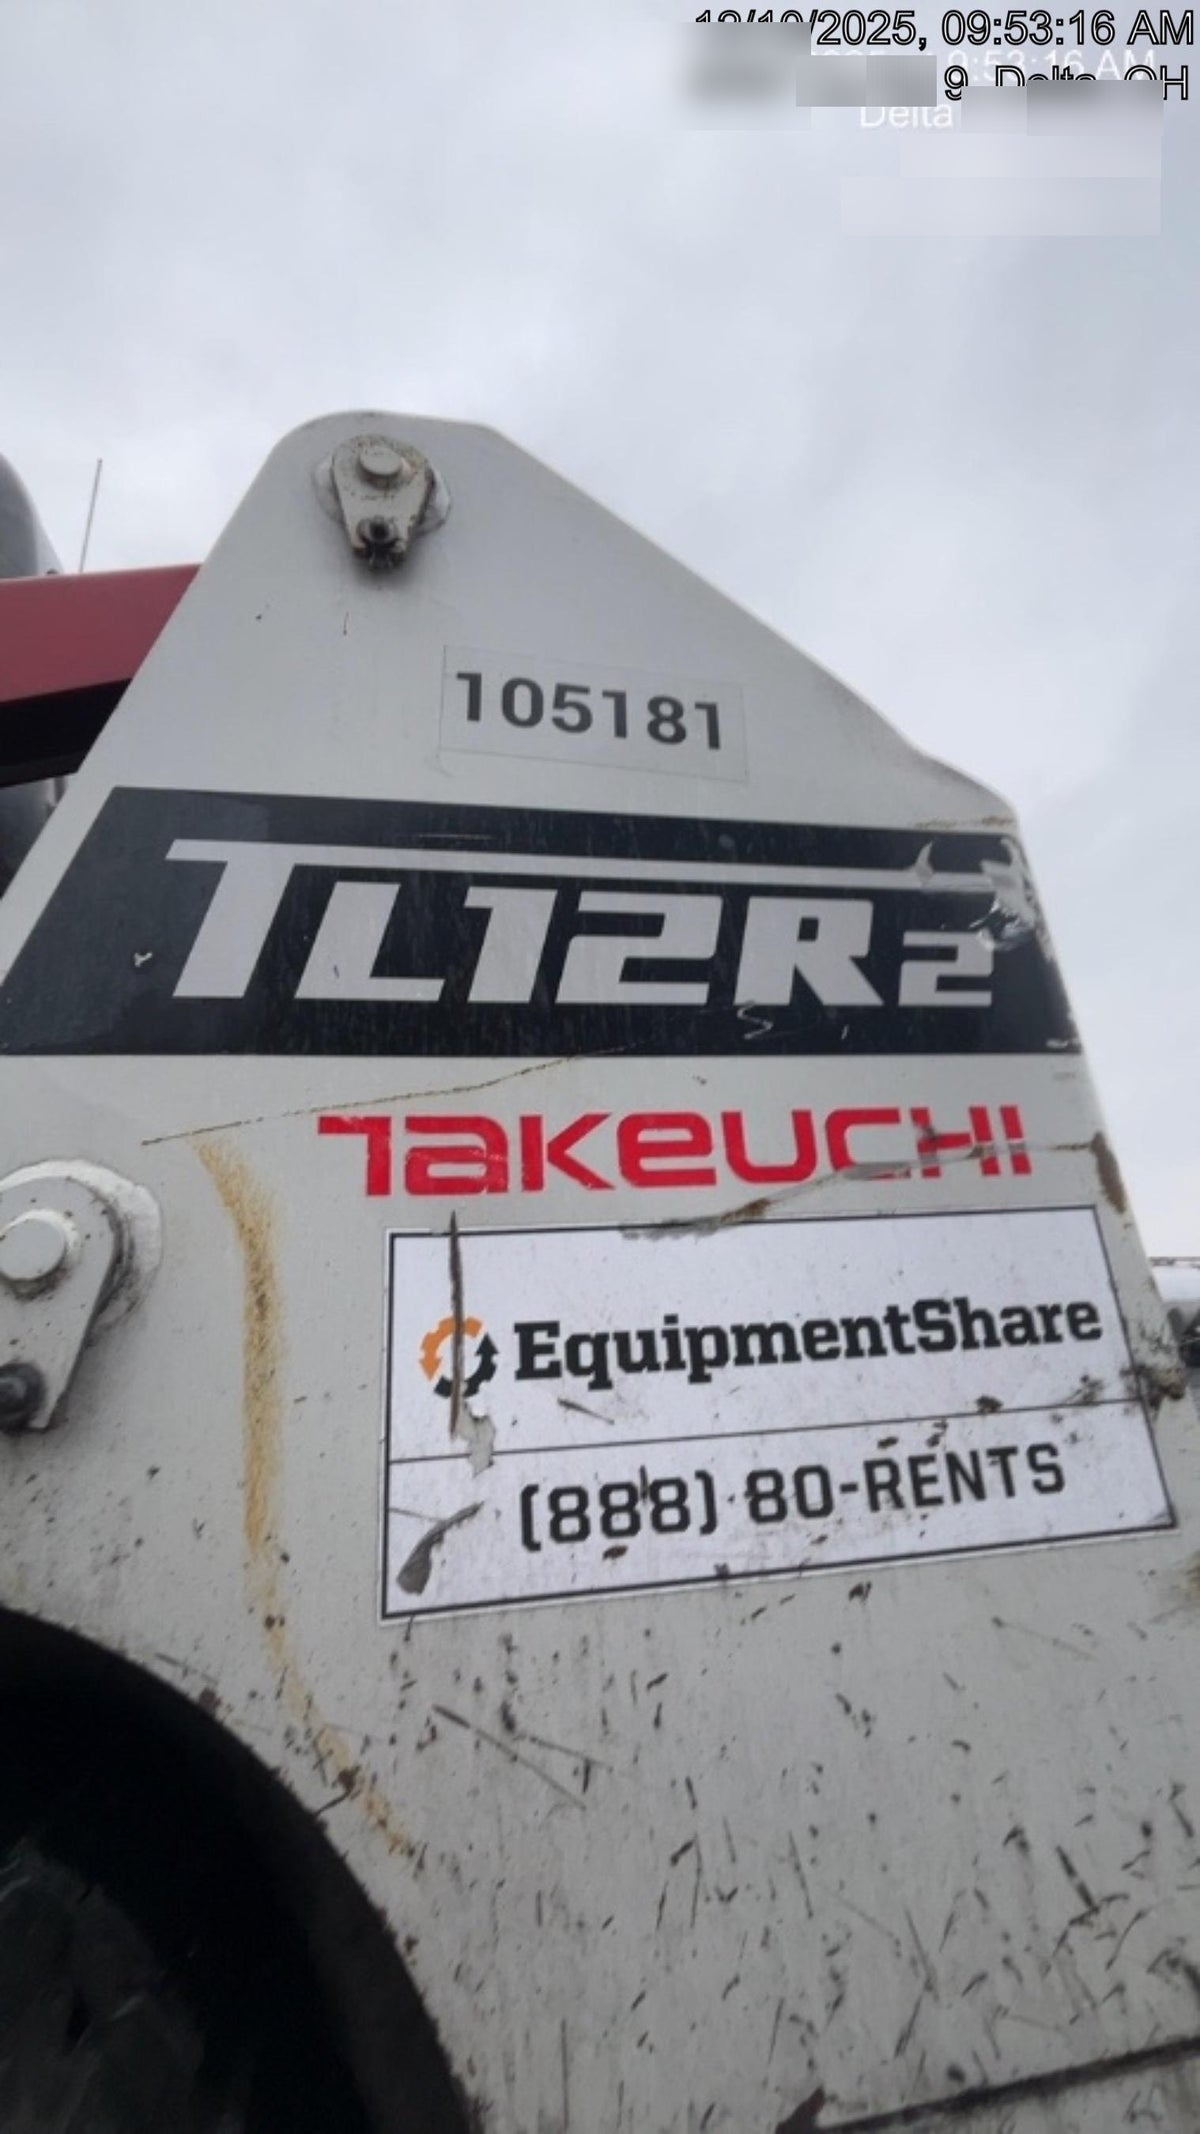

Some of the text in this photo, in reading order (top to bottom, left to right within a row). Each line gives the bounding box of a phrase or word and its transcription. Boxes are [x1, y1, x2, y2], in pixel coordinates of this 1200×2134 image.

[456, 671, 722, 750] 105181
[513, 1297, 1103, 1391] EquipmentShare
[520, 1444, 1066, 1552] (888) 80-RENTS
